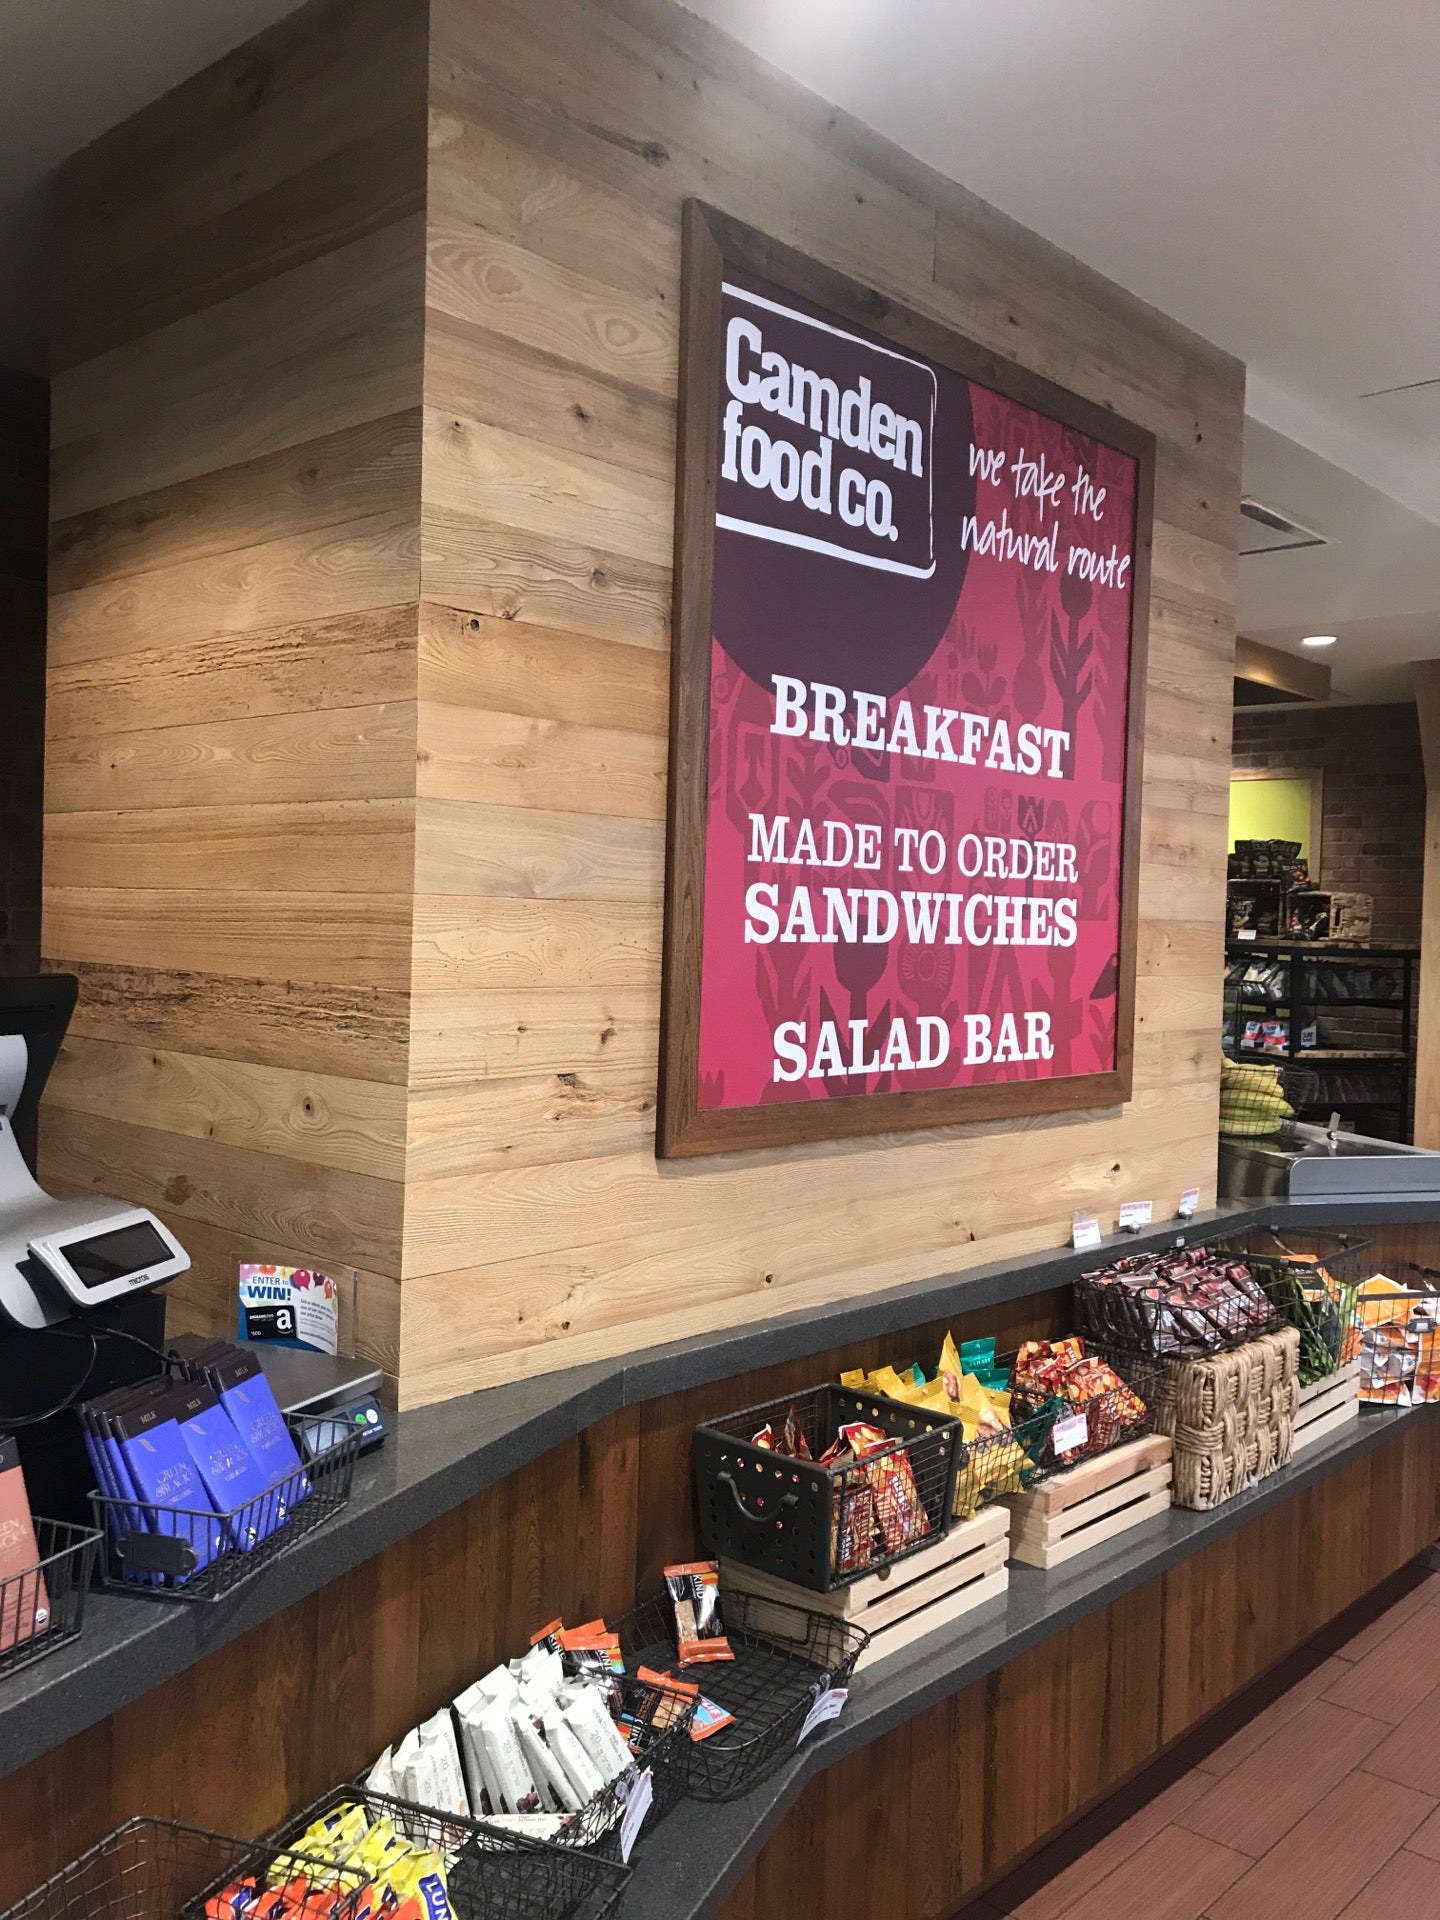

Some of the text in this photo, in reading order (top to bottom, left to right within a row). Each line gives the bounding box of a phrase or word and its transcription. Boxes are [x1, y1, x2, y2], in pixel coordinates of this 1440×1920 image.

[725, 316, 924, 478] Camden
[721, 400, 899, 542] food co.
[968, 443, 1107, 521] we take the
[961, 508, 1131, 589] natural route
[770, 674, 1070, 779] BREAKFAST
[747, 813, 1078, 883] MADE TO ORDER
[744, 882, 1078, 947] SANDWICHES
[773, 1011, 1054, 1083] SALAD BAR
[247, 1285, 292, 1301] WIN!
[252, 1276, 281, 1285] ENTER
[139, 1410, 158, 1425] MILK
[692, 1574, 705, 1599] KIND
